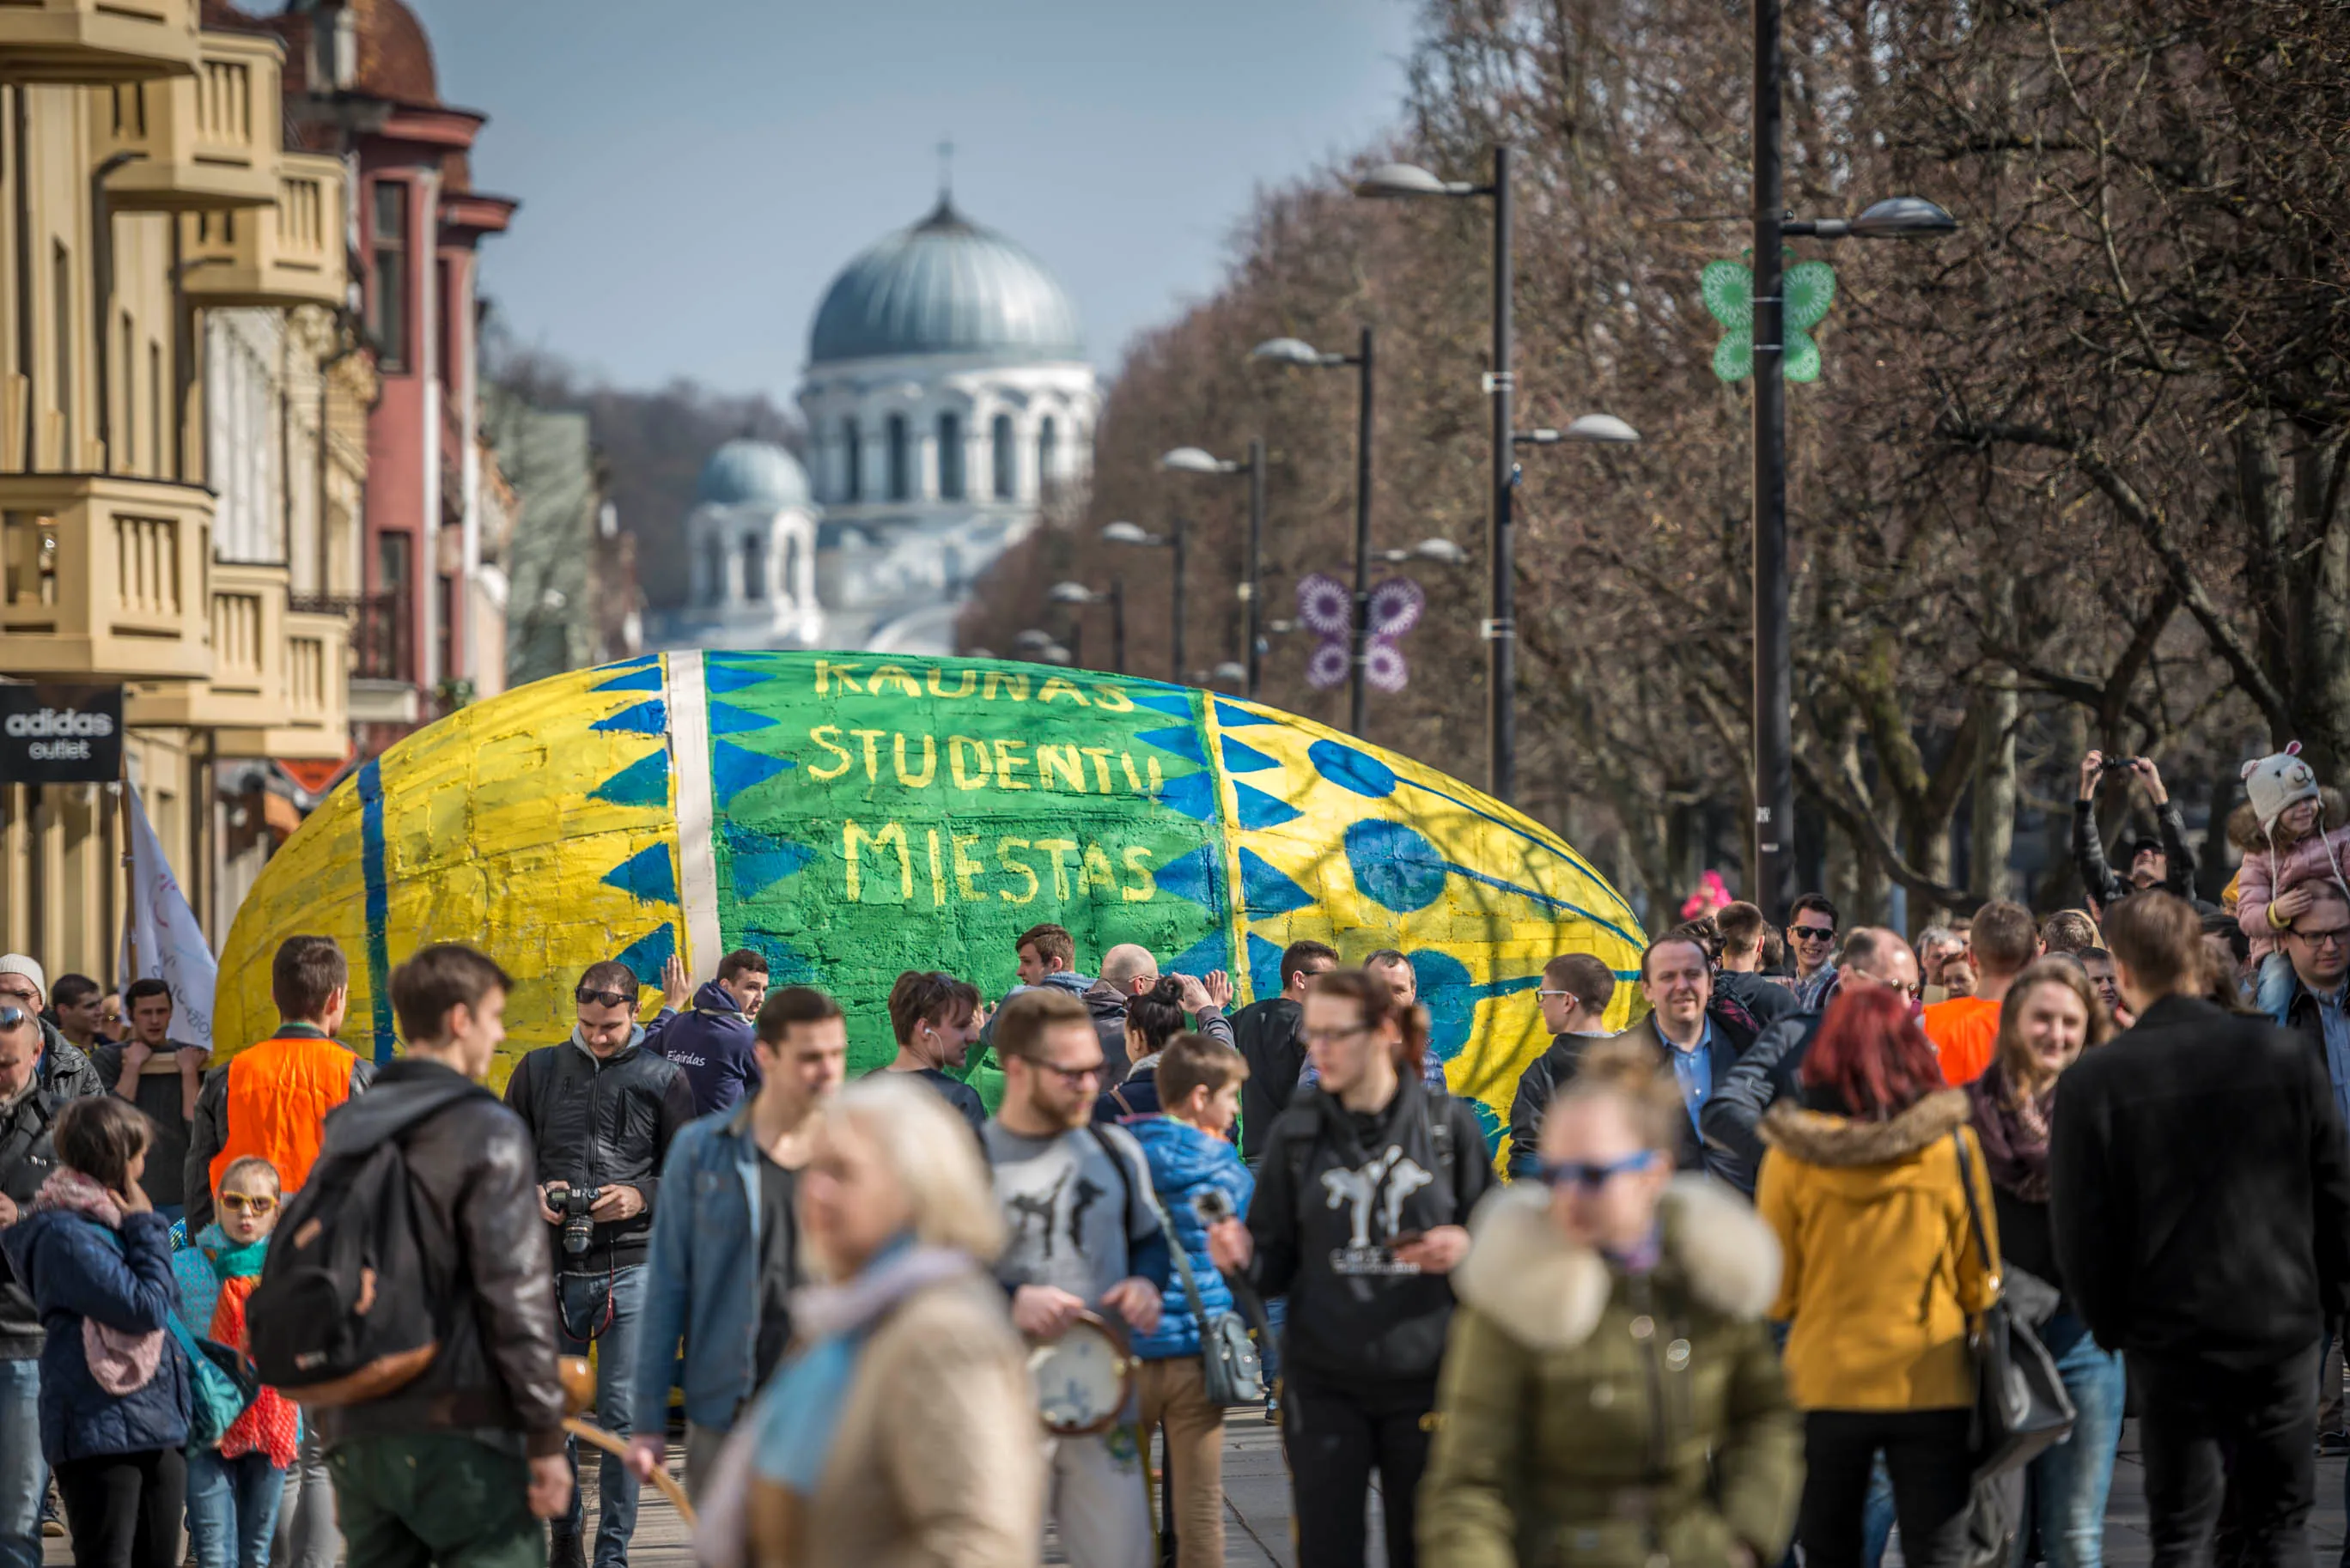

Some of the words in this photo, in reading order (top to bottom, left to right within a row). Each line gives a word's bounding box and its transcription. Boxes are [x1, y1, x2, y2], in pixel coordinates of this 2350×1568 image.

[814, 660, 1135, 712] KAUNAS
[5, 708, 113, 737] adidas
[28, 738, 91, 760] outlet
[843, 818, 1156, 907] MIESTAS
